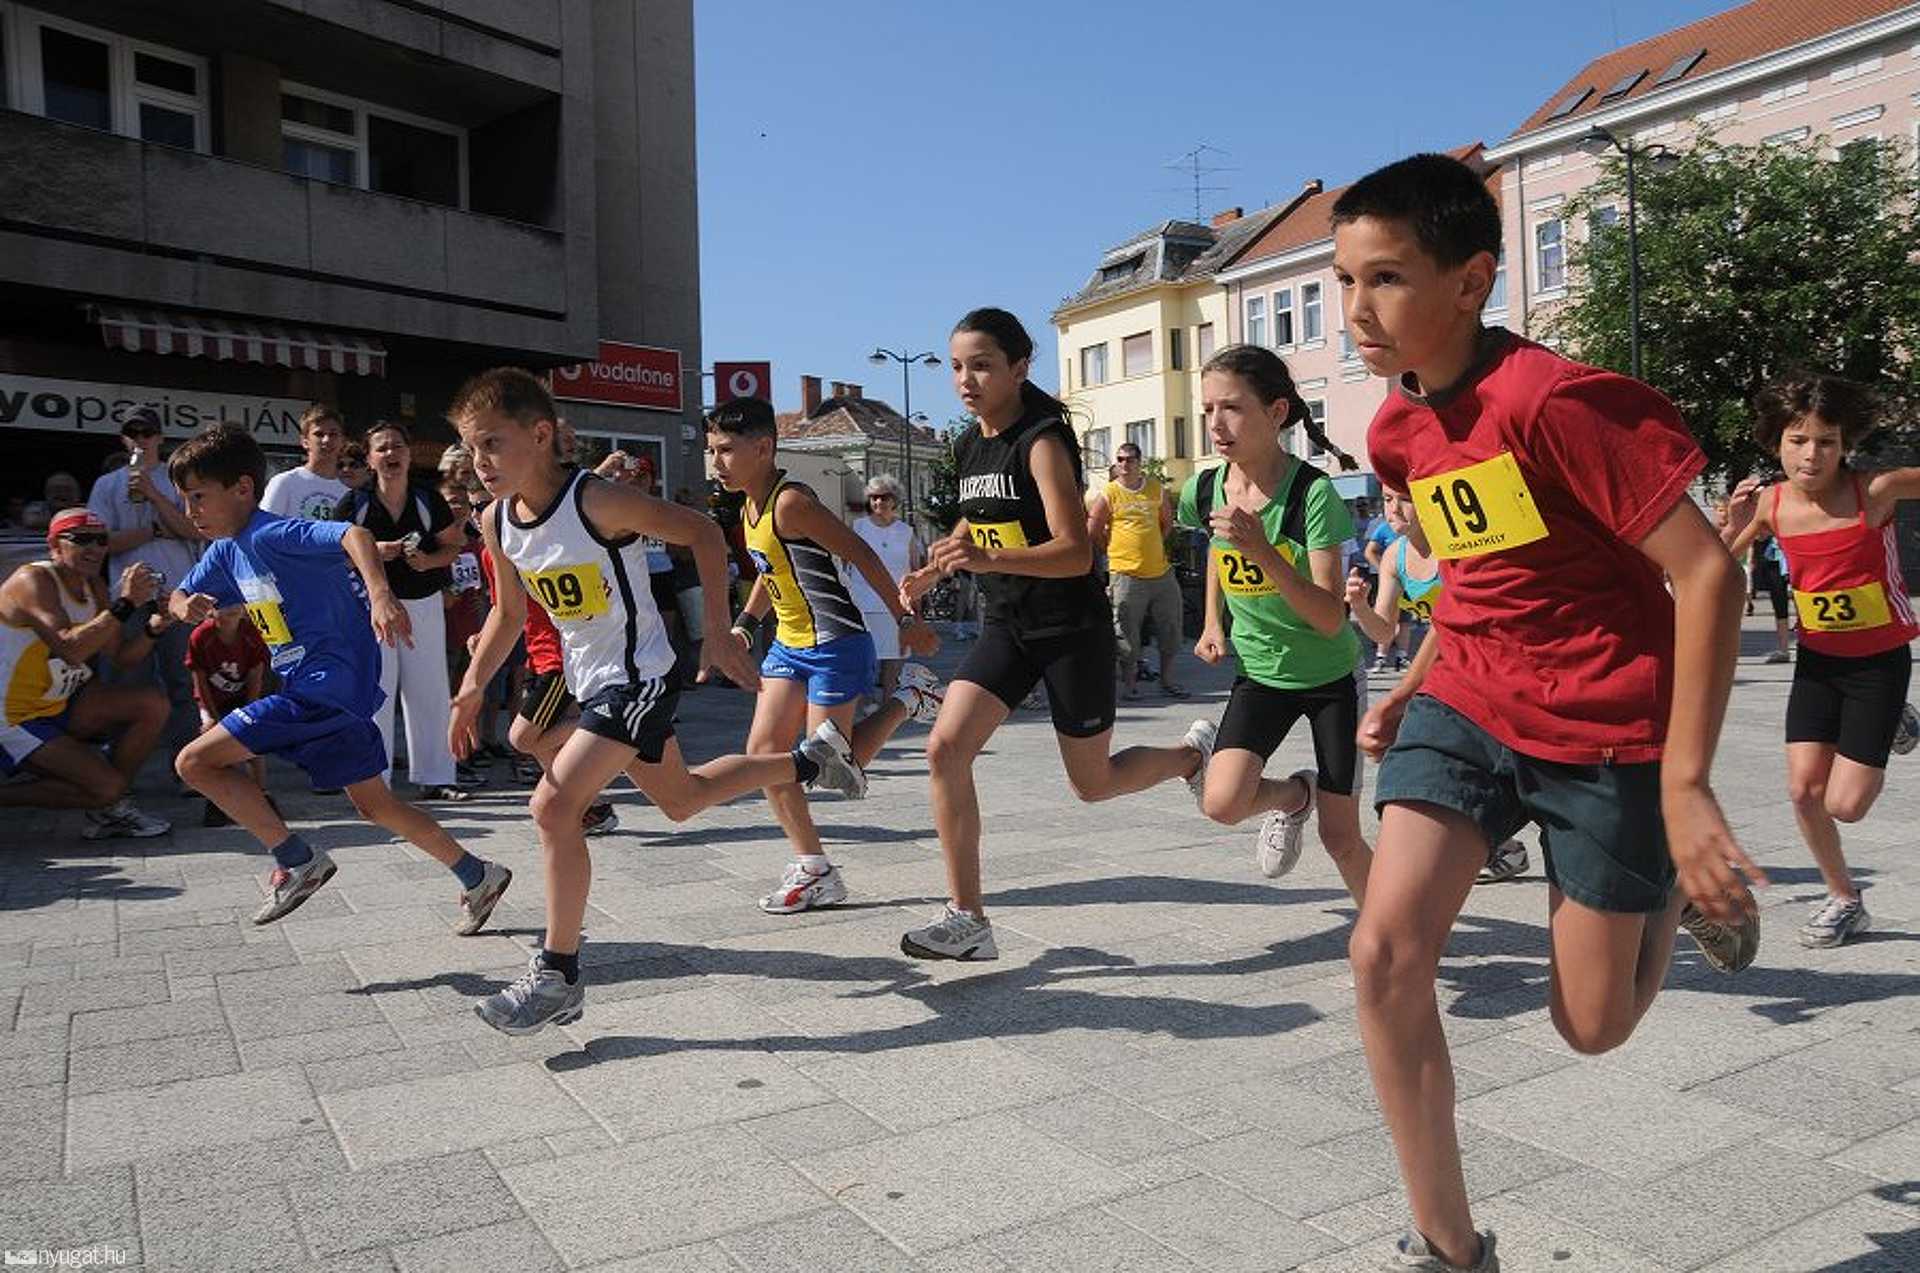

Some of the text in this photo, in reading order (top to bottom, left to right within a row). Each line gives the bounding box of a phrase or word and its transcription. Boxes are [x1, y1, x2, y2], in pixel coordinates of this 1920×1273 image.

[588, 362, 674, 387] vodafone
[1430, 479, 1488, 537] 19
[1222, 554, 1264, 585] 25
[1812, 594, 1857, 621] 23
